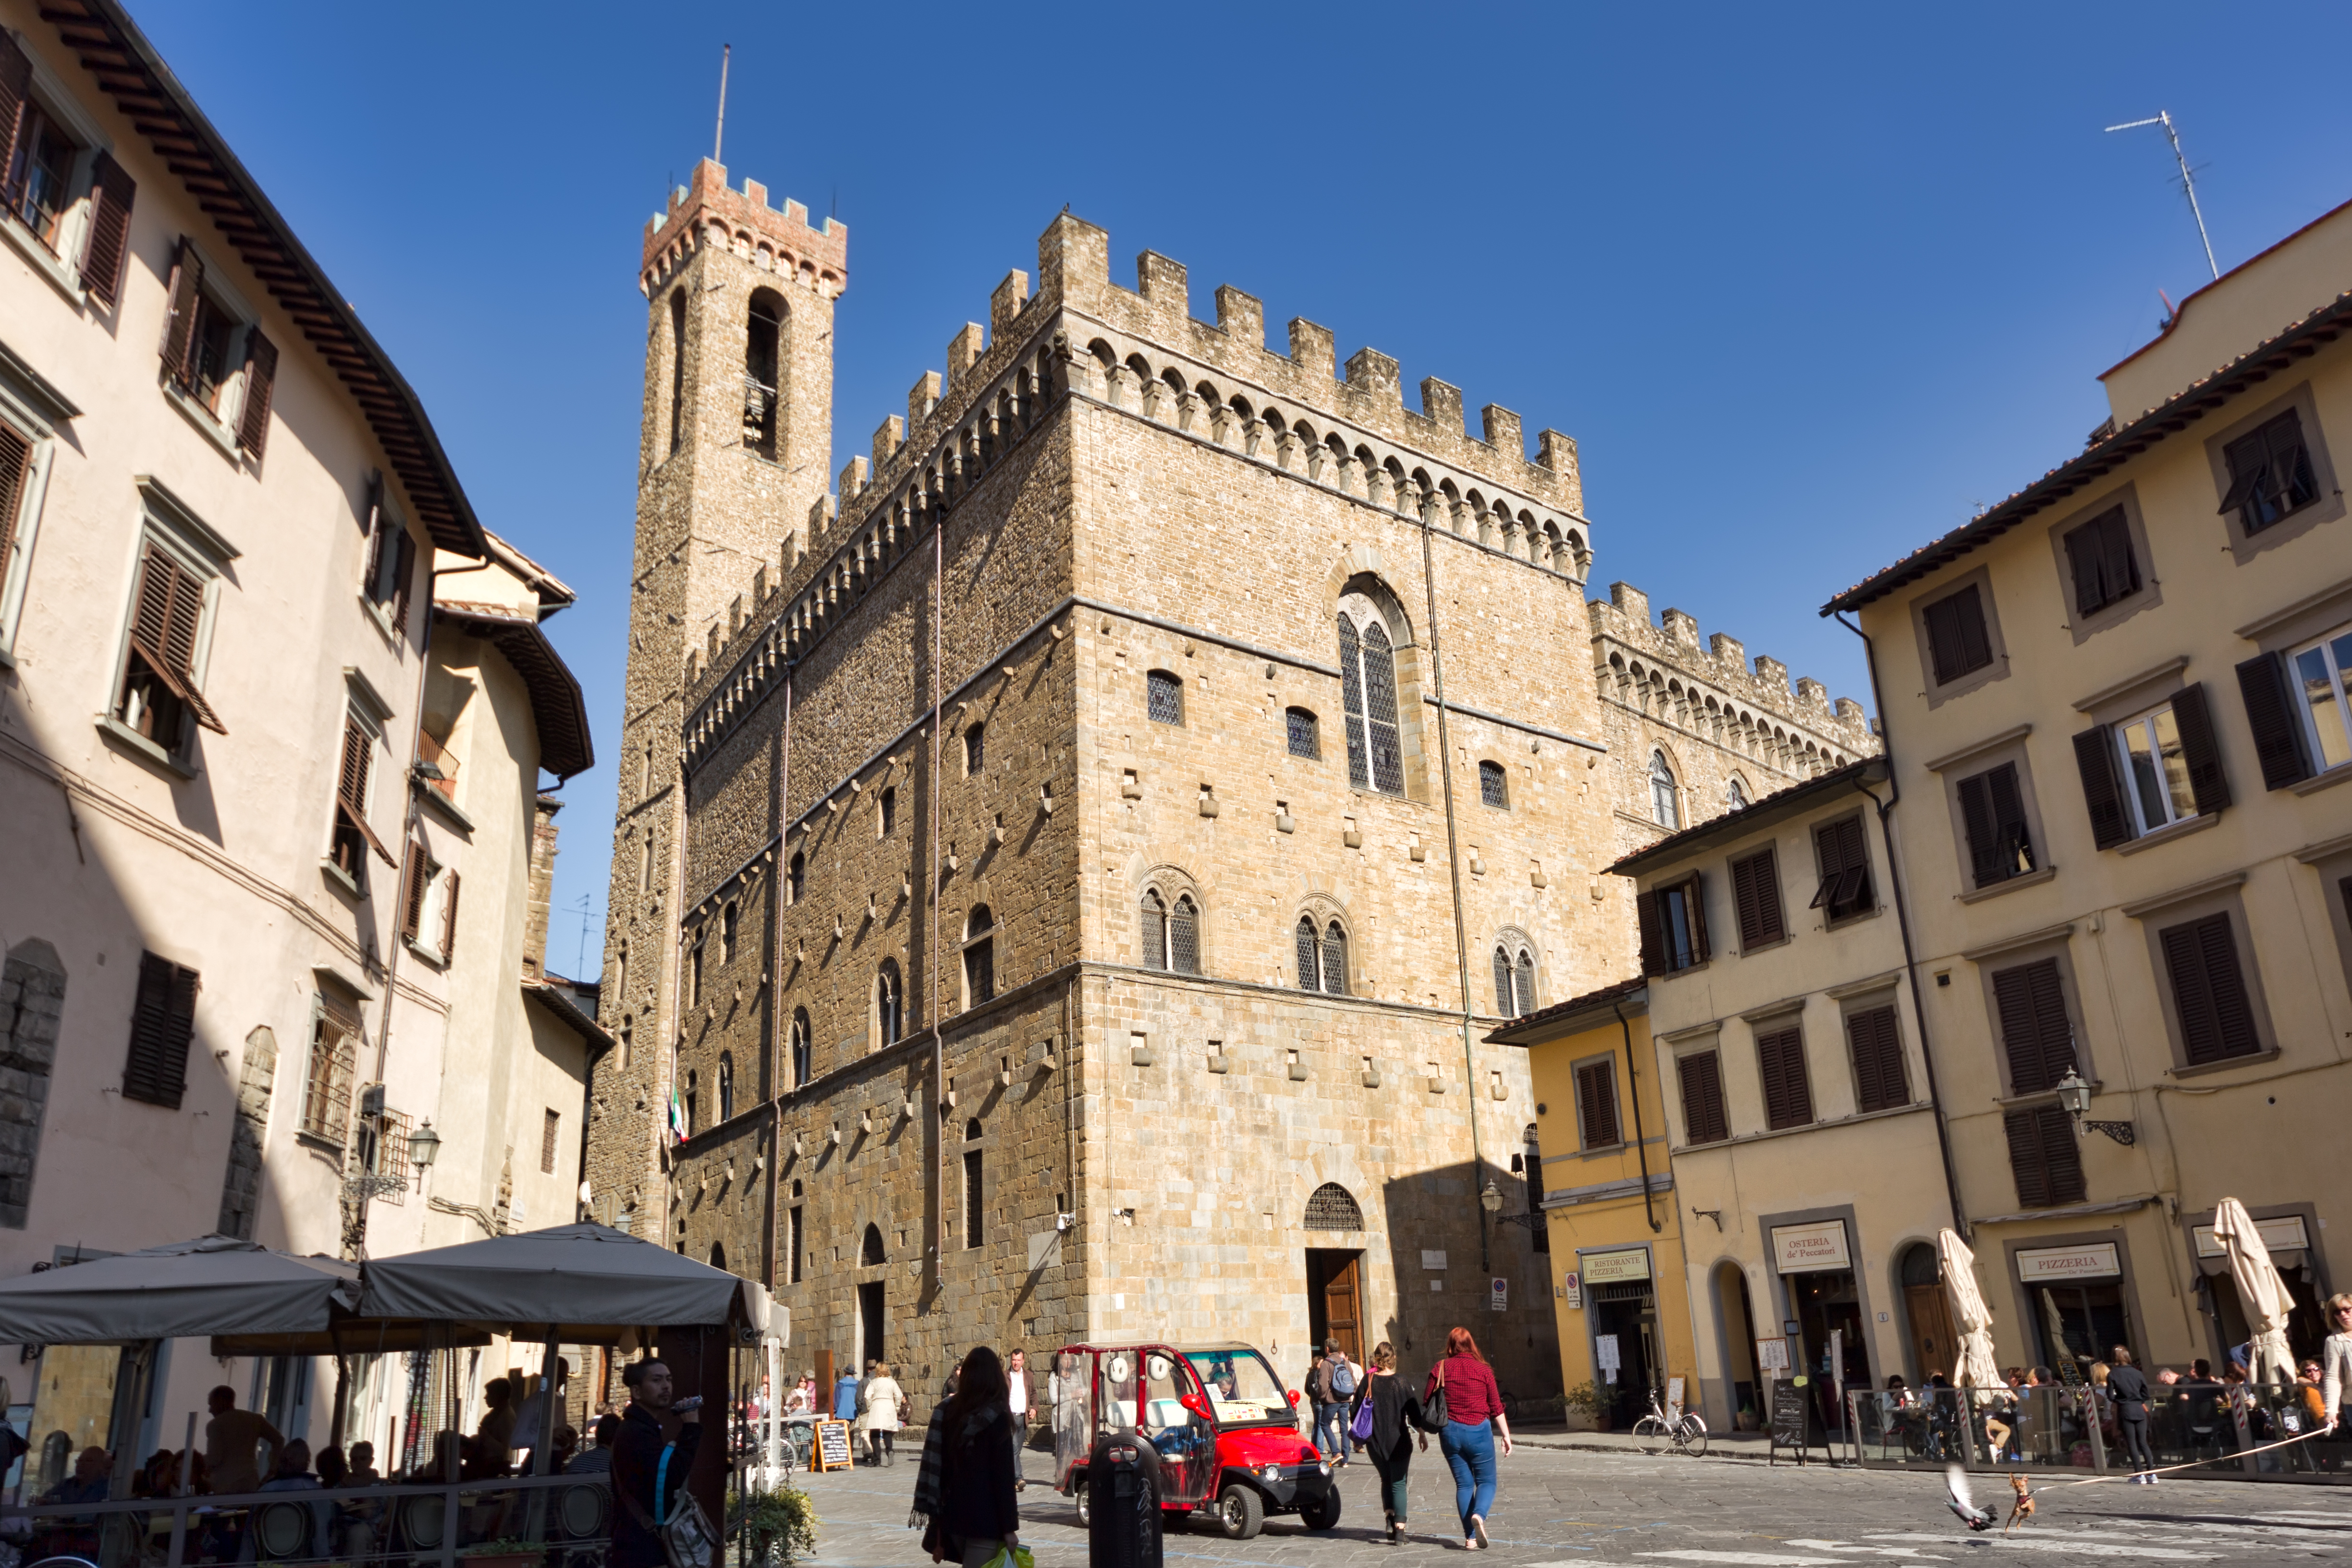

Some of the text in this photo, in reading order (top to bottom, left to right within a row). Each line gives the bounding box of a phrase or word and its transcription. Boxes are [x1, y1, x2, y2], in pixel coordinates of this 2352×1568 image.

[1789, 1237, 1829, 1248] OSTERIA
[1787, 1250, 1797, 1258] de'
[1594, 1257, 1641, 1267] RISTORANTE
[2038, 1257, 2097, 1270] PIZZERIA
[1590, 1267, 1623, 1276] PIZZERIA
